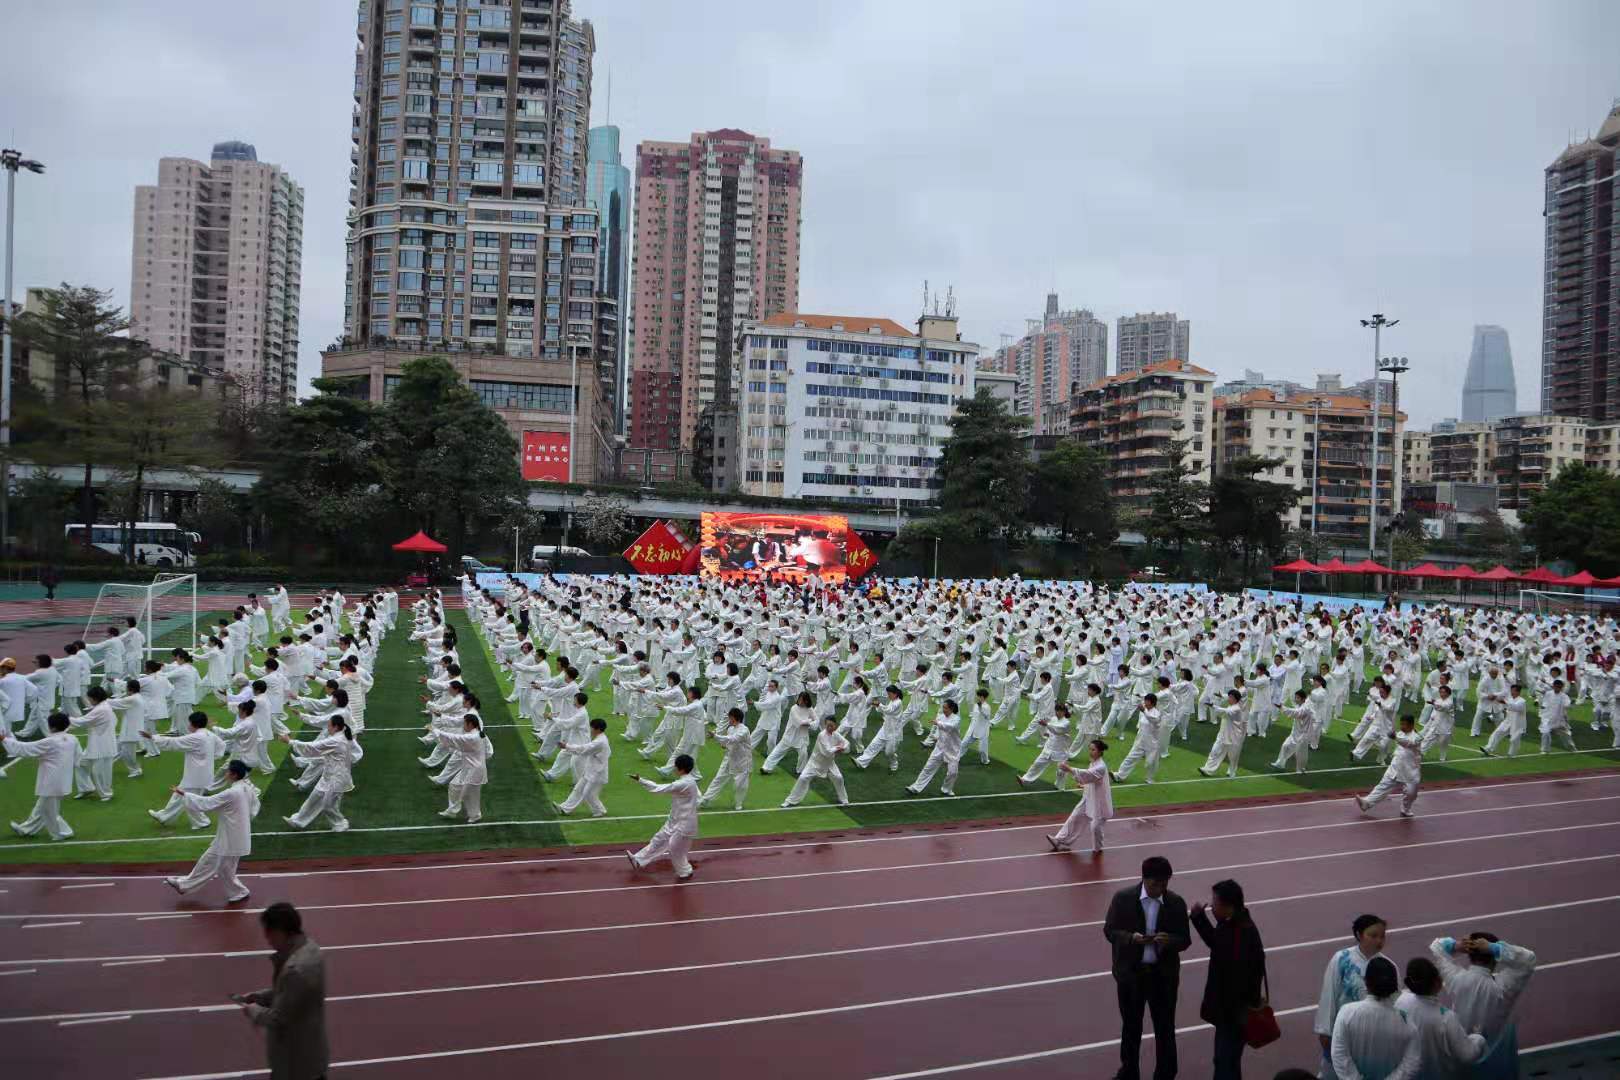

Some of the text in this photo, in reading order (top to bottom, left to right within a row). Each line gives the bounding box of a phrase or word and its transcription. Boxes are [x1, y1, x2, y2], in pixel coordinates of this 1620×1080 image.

[630, 543, 685, 562] 不忘初心
[849, 547, 870, 568] 使命
